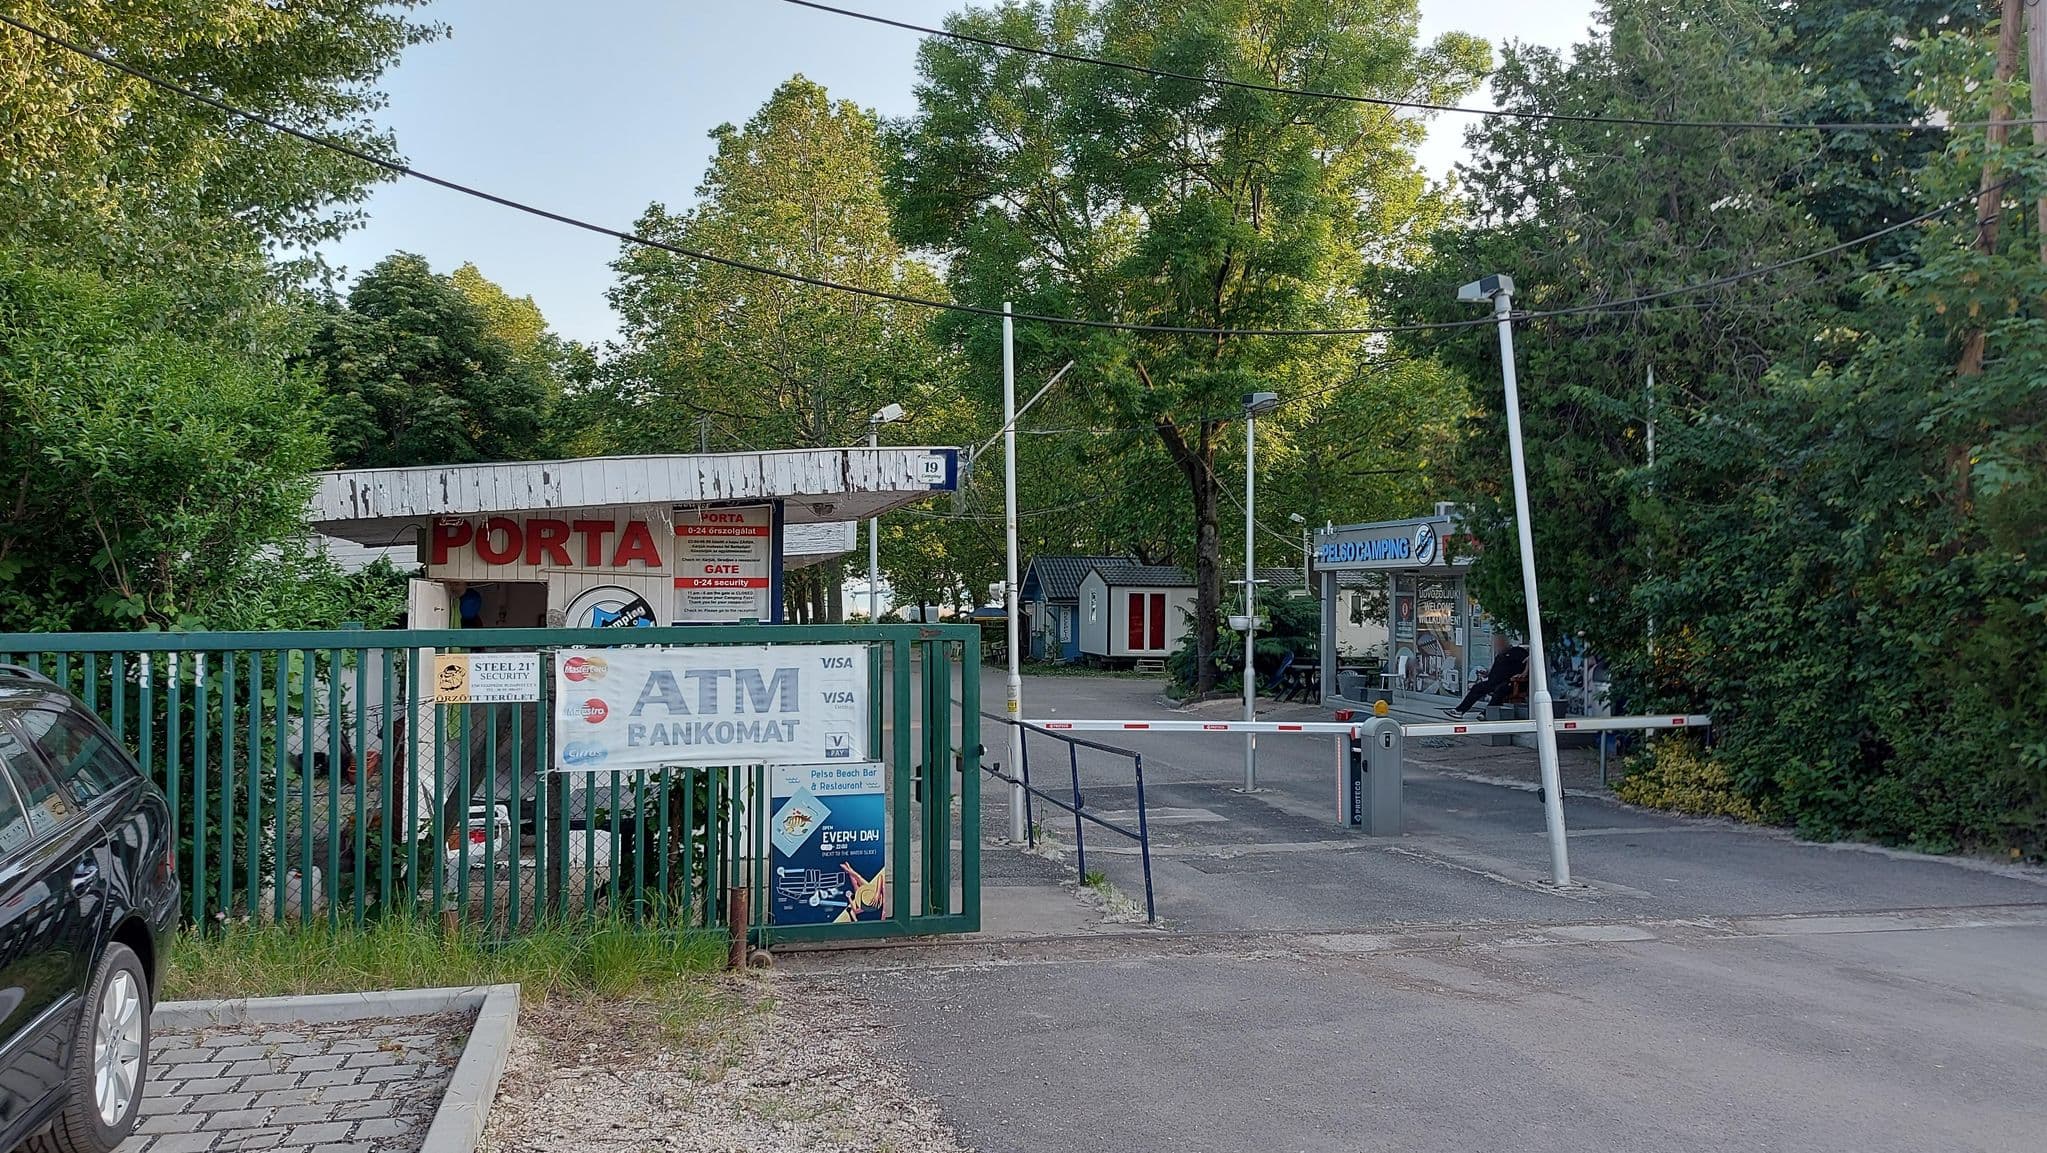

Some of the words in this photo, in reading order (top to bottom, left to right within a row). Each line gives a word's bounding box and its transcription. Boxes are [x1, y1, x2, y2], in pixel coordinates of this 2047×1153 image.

[925, 461, 939, 474] 19
[701, 513, 745, 523] PORTA
[687, 526, 707, 535] 0-24
[431, 516, 663, 568] PORTA
[1322, 542, 1356, 563] PELSO
[1356, 537, 1411, 562] CAMPING
[704, 564, 740, 574] GATE
[713, 579, 749, 588] security
[1424, 602, 1455, 612] WELCOME
[607, 606, 646, 628] mping
[474, 662, 516, 672] STEEL
[820, 657, 853, 669] VISA
[564, 664, 609, 674] MasterCard
[480, 672, 530, 680] SECURITY
[629, 667, 800, 716] ATM
[822, 691, 855, 704] VISA
[567, 707, 605, 716] Maestro
[628, 719, 801, 747] BANKOMAT
[831, 736, 843, 747] V
[568, 748, 603, 758] Cirrus
[830, 750, 845, 758] PAY
[810, 769, 834, 779] Pelso
[836, 769, 860, 778] Beach
[863, 768, 877, 777] Bar
[810, 782, 817, 791] &
[820, 781, 863, 791] Restaurant
[822, 830, 857, 843] EVERY
[860, 829, 880, 842] DAY
